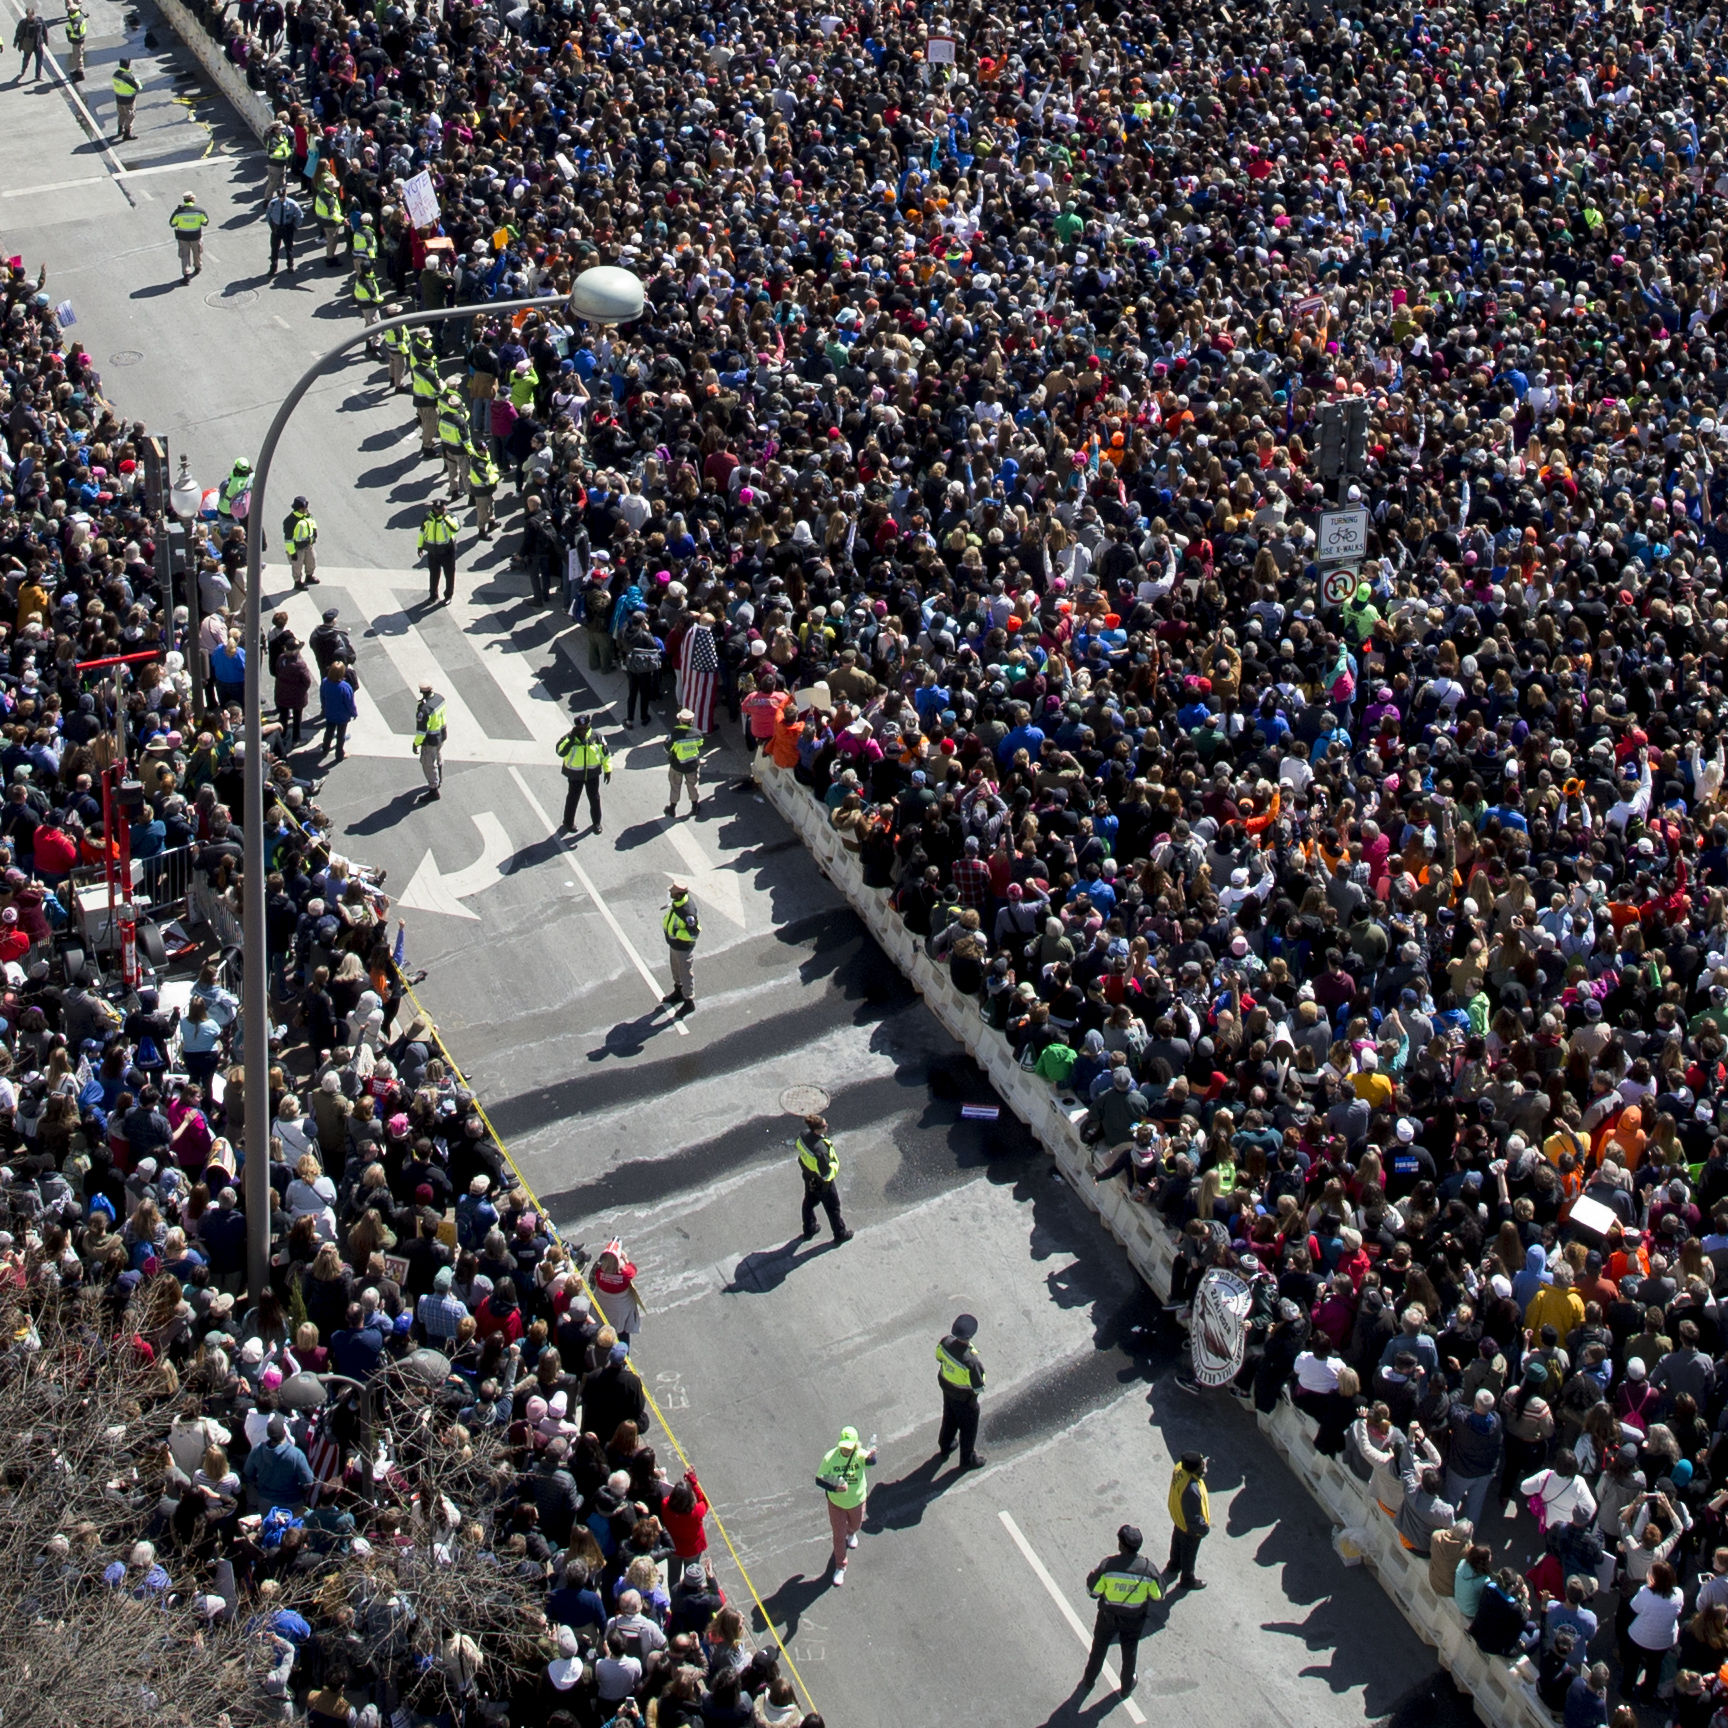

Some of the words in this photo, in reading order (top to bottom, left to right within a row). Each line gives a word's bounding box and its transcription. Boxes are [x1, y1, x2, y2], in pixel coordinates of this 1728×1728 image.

[403, 175, 429, 197] VOTE
[1330, 515, 1359, 526] TURNING
[1320, 546, 1335, 555] USE
[1336, 543, 1364, 554] X-WALKS
[1113, 1582, 1139, 1594] POLICE
